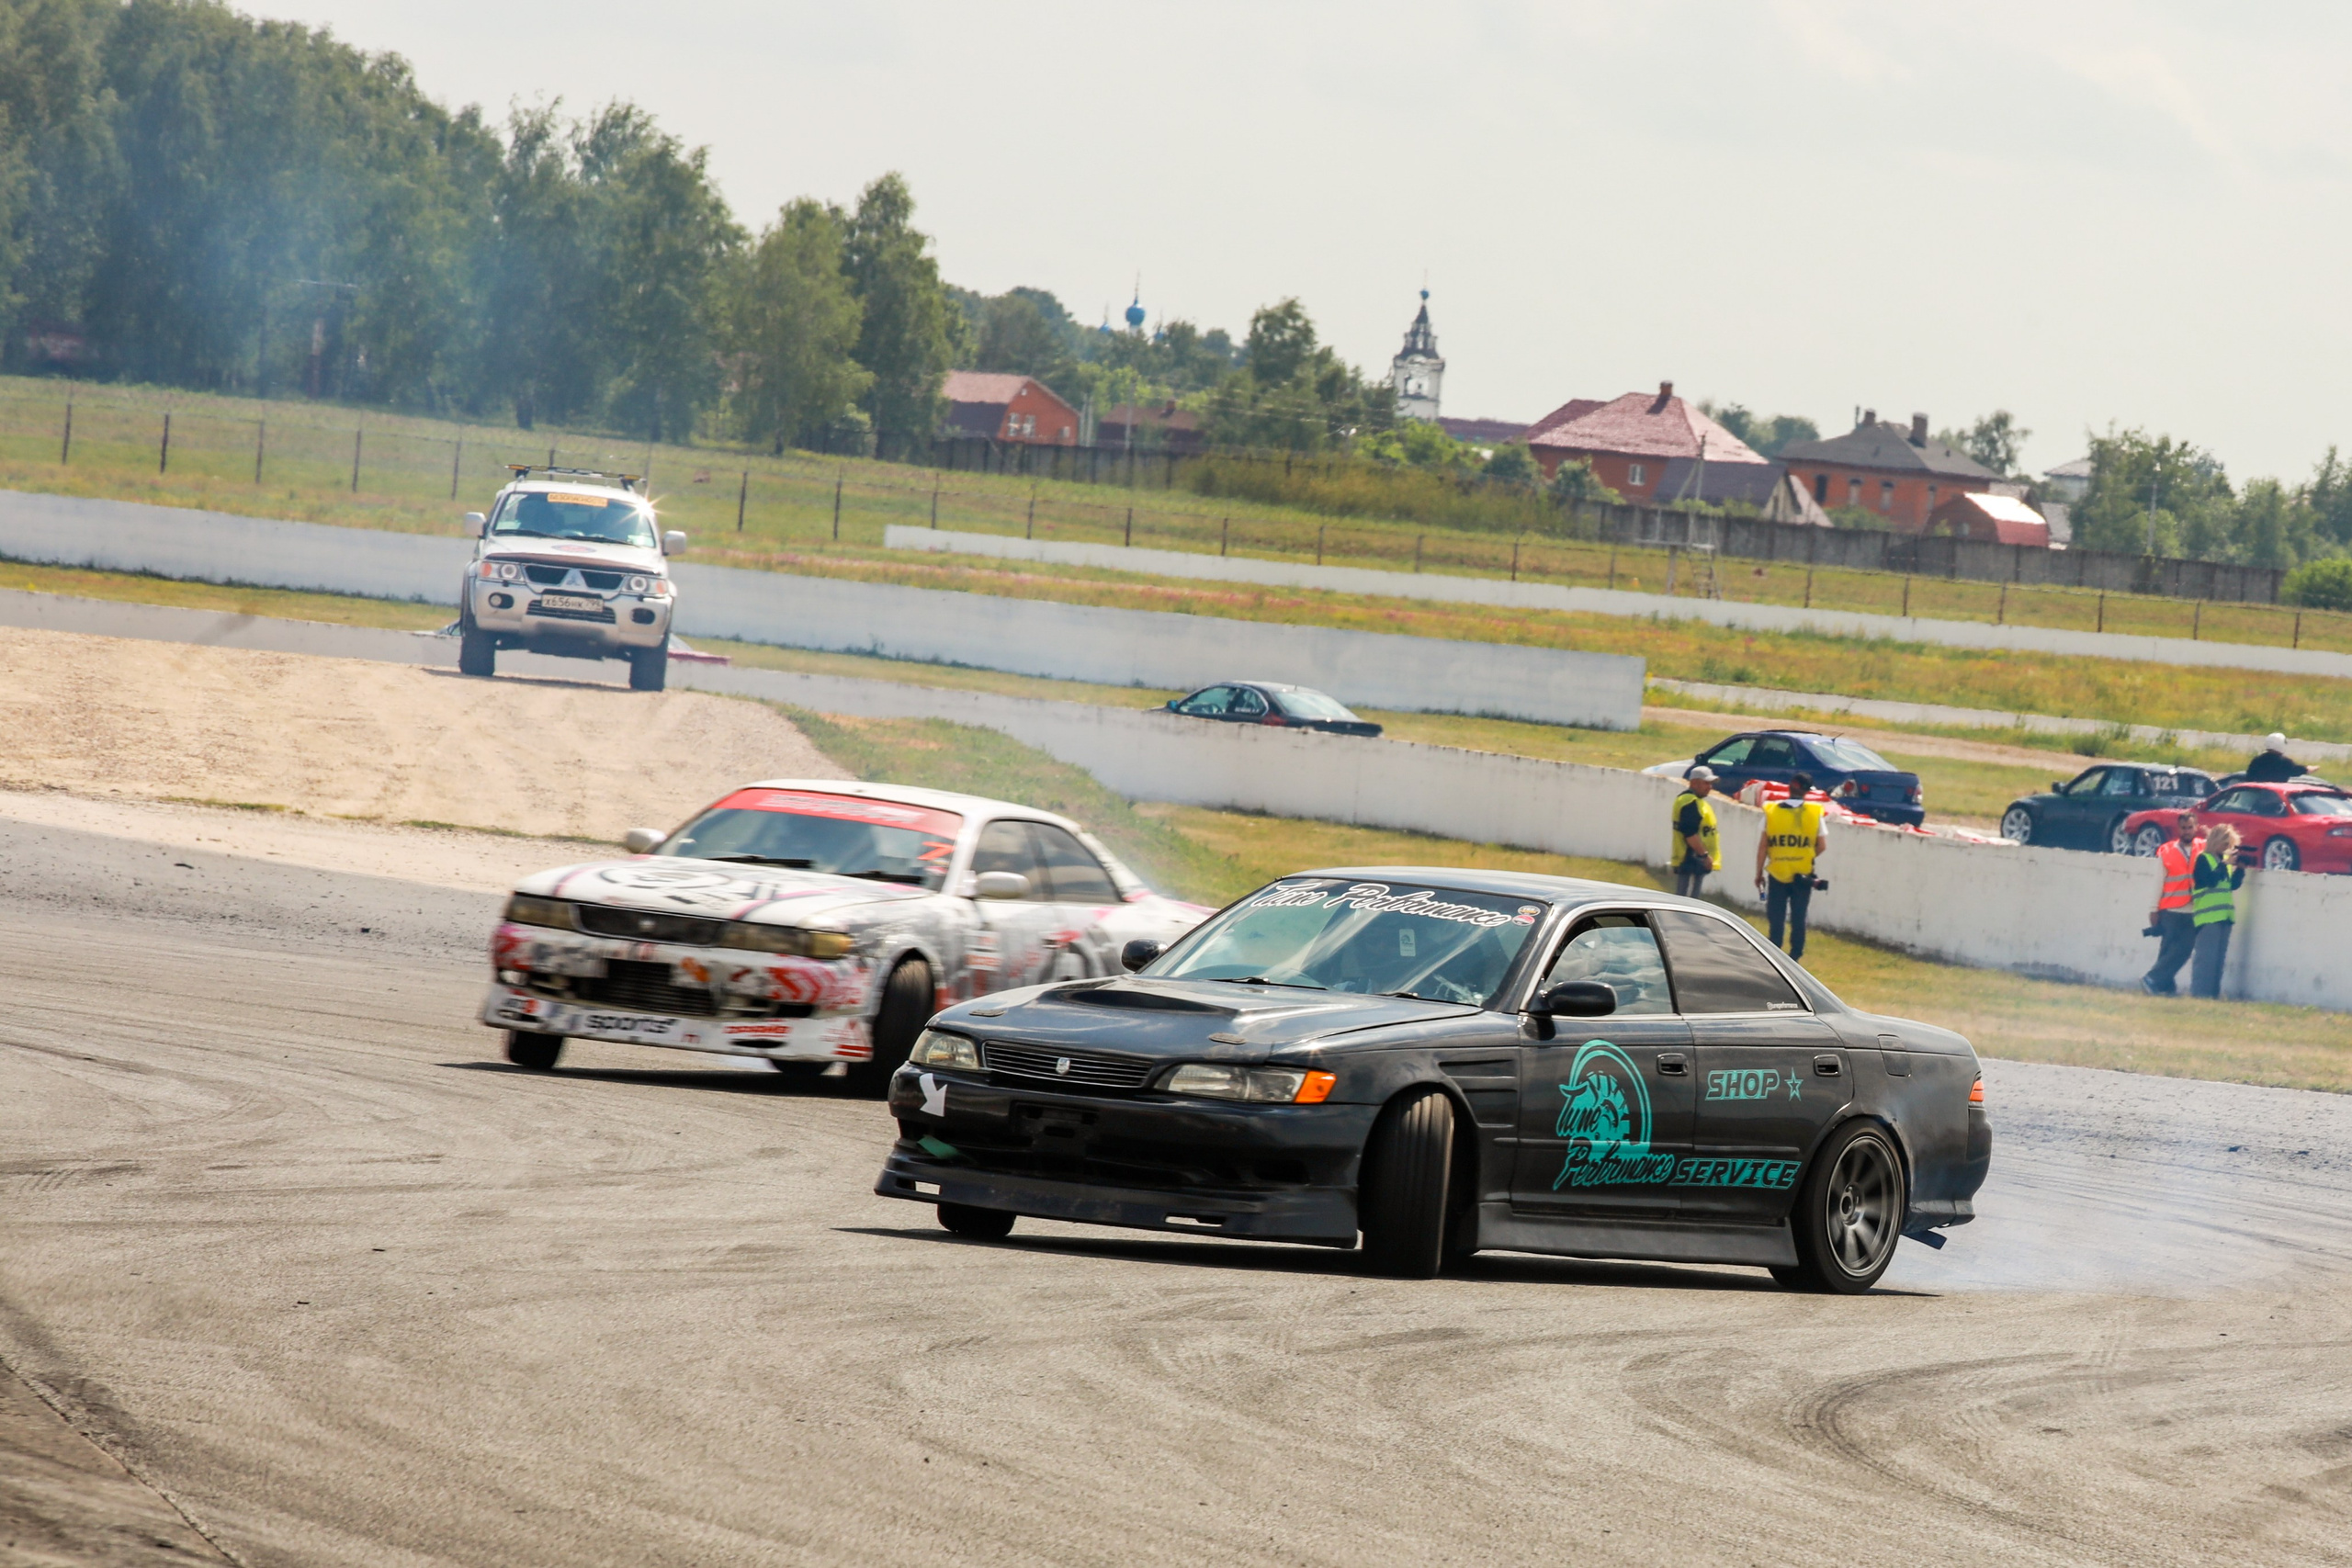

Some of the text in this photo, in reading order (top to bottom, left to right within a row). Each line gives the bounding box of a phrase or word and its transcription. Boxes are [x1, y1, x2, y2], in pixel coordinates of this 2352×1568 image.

[2153, 775, 2178, 791] 121
[1768, 834, 1810, 848] MEDIA
[1250, 883, 1328, 908] Tune
[1323, 883, 1511, 927] Performance
[1705, 1068, 1780, 1100] SHOP
[1556, 1083, 1600, 1136] Tune
[1553, 1136, 1674, 1190] Performance
[1667, 1157, 1803, 1190] SERVICE
